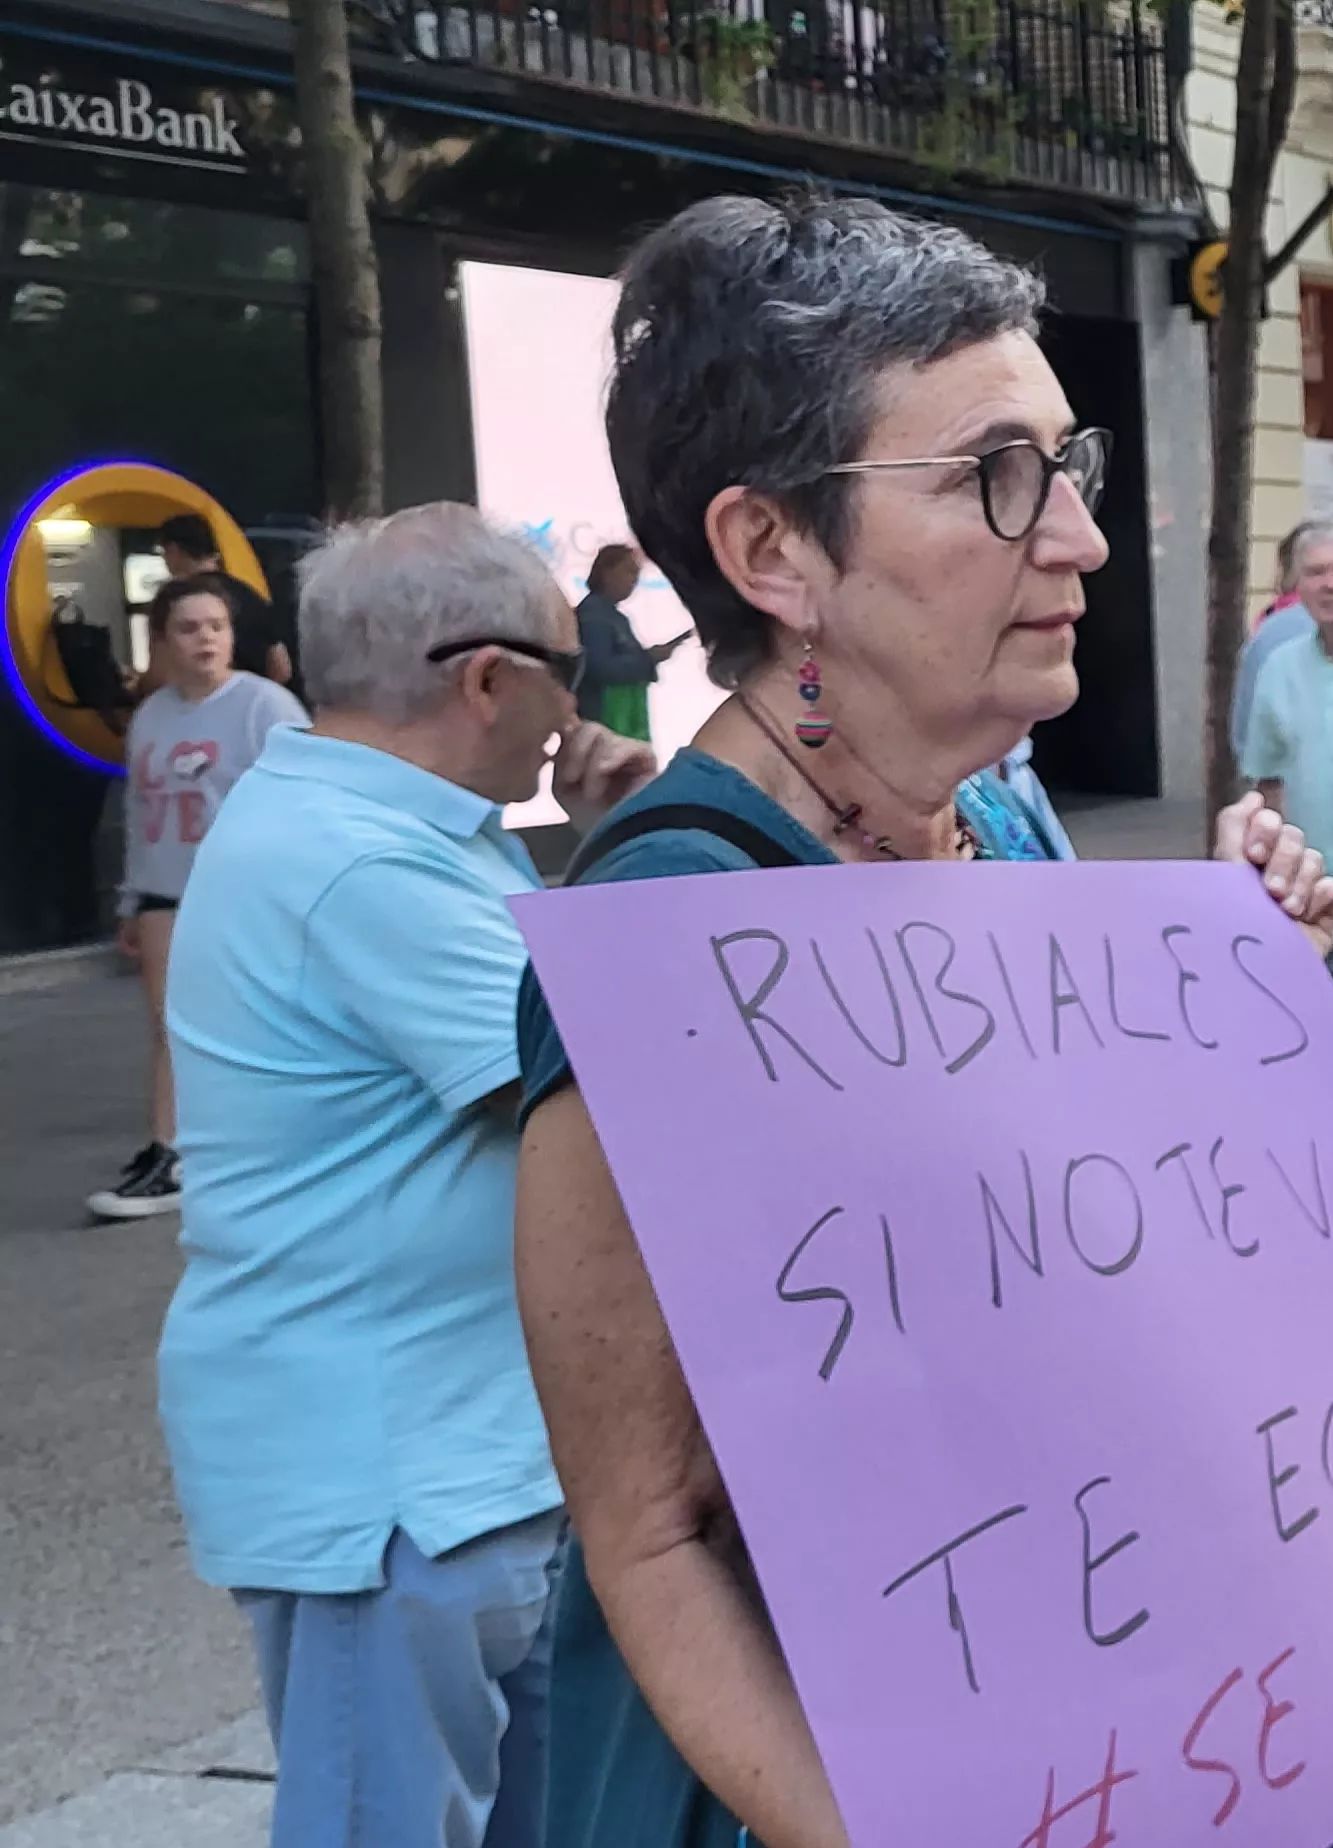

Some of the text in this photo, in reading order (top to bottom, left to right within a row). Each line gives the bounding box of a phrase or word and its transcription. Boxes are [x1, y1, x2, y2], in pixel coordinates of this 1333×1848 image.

[0, 58, 247, 157] aixaBank
[710, 920, 1309, 1091] RUBIALES
[776, 1206, 906, 1380] SI
[978, 1149, 1145, 1308] NO
[1153, 1136, 1260, 1258] TE
[883, 1476, 1150, 1694] TE
